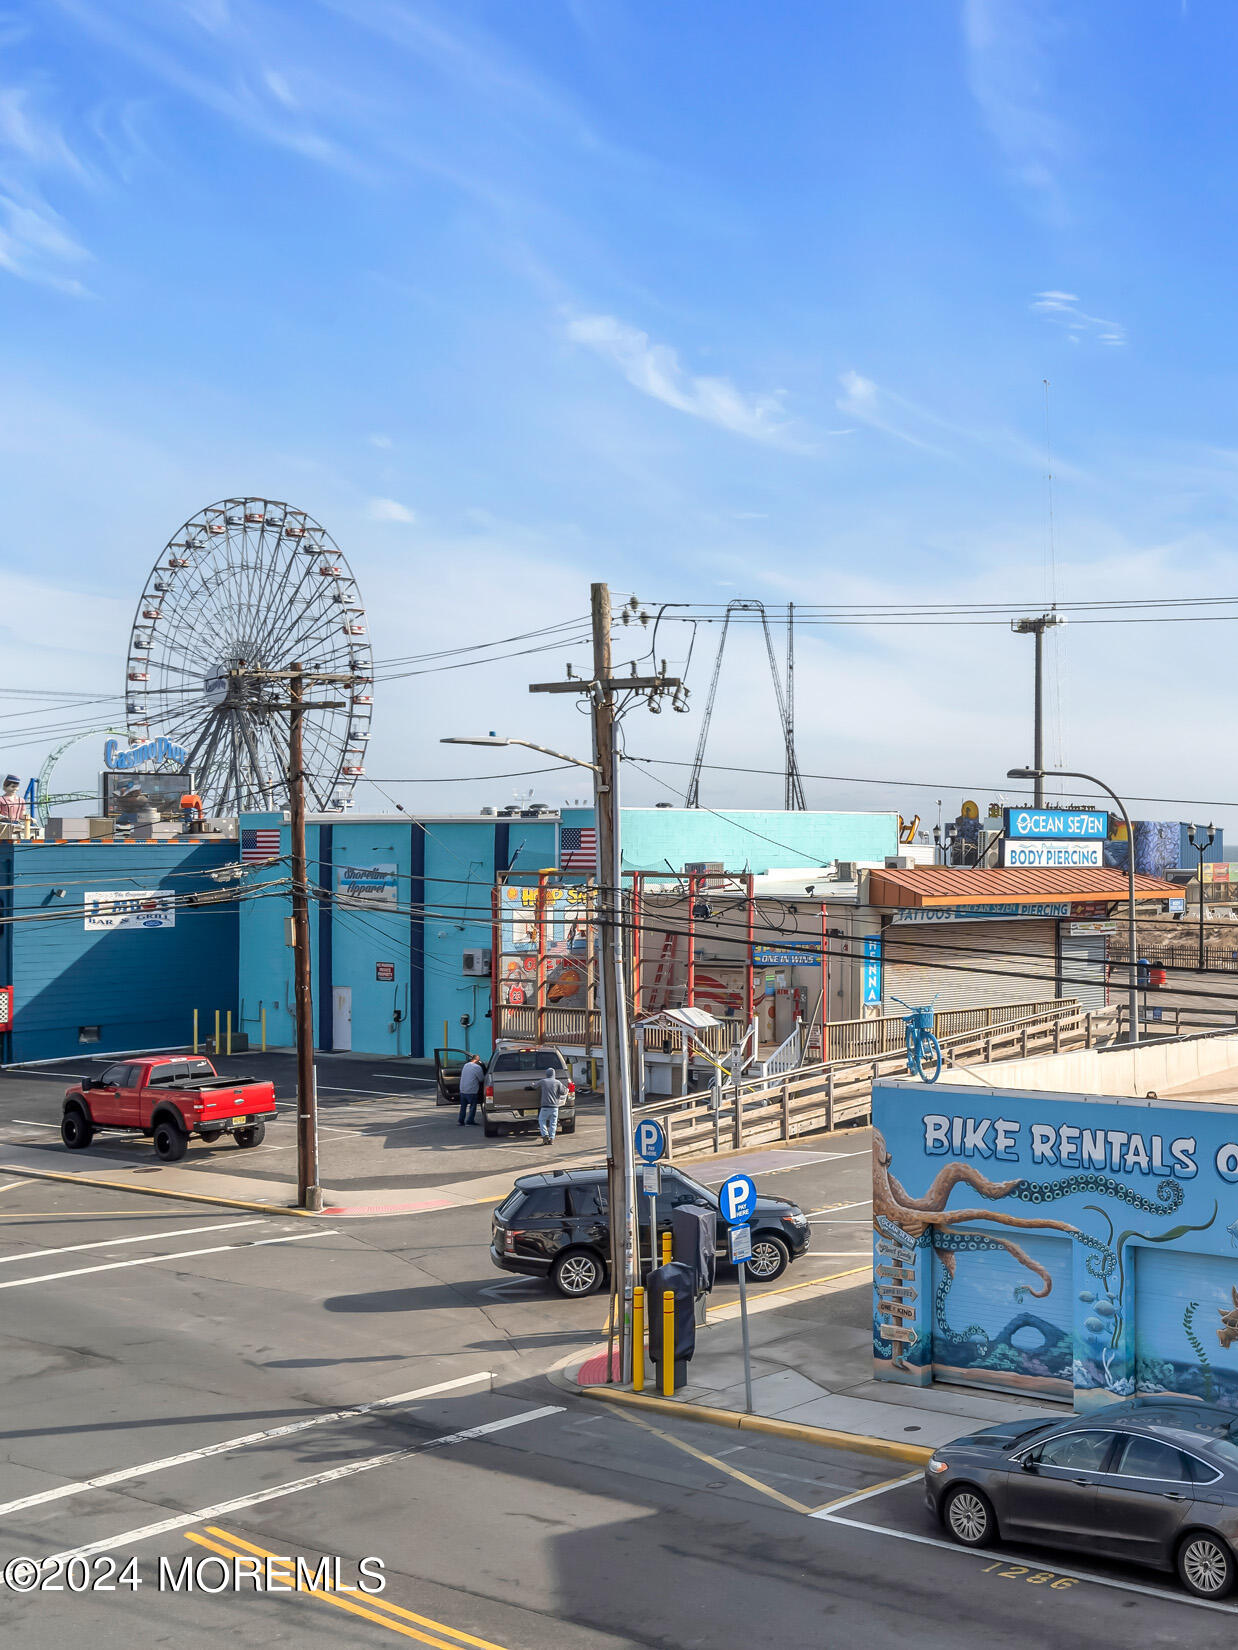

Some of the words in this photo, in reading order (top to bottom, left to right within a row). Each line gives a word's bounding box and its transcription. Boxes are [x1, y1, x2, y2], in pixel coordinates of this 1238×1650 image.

[104, 738, 156, 770] Casino
[155, 736, 189, 765] Pier
[1017, 813, 1063, 834] OCEAN
[1068, 815, 1103, 834] SE7EN
[1010, 850, 1044, 865] BODY
[1046, 850, 1098, 865] PIERCING
[347, 881, 386, 896] Apparel
[899, 908, 951, 920] TATTOOS
[1021, 904, 1068, 915] PIERCING
[761, 955, 779, 963] ONE
[791, 956, 814, 964] WINS
[868, 940, 877, 1000] HENNA
[513, 992, 521, 1001] 23
[641, 1124, 658, 1156] P
[923, 1114, 1020, 1162] BIKE
[1031, 1123, 1198, 1179] RENTALS
[728, 1180, 750, 1219] P
[736, 1209, 750, 1217] HERE
[897, 1308, 913, 1317] KIND
[981, 1562, 1080, 1589] 1286
